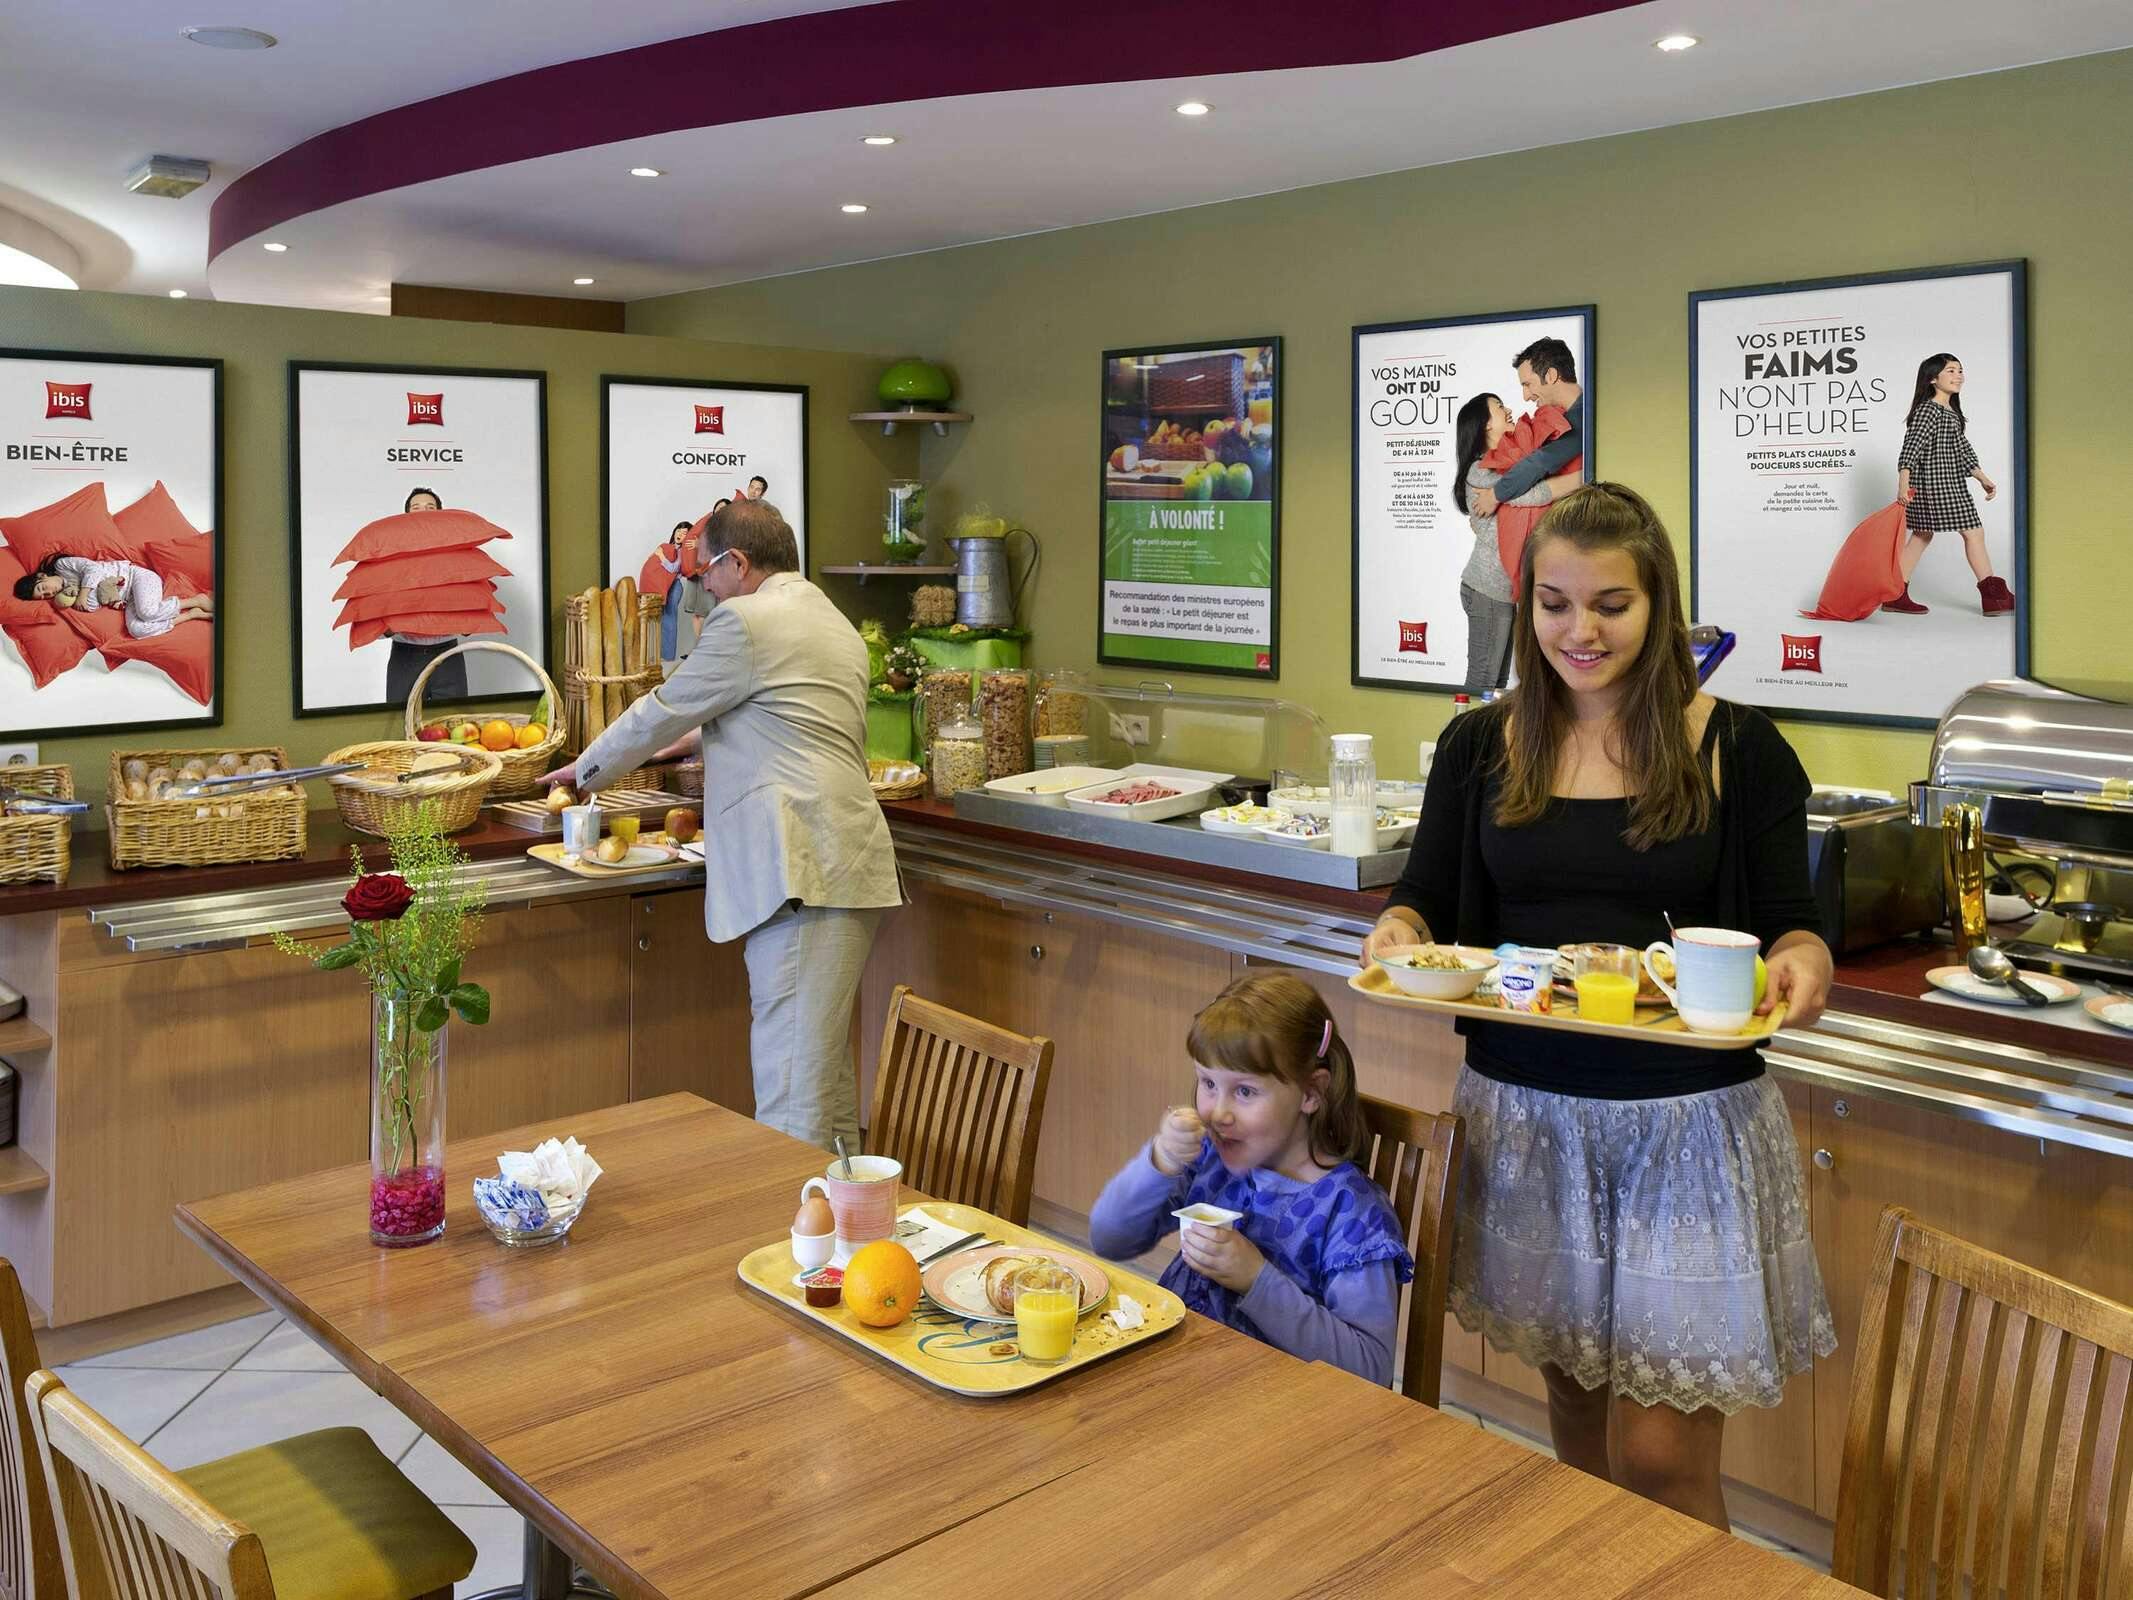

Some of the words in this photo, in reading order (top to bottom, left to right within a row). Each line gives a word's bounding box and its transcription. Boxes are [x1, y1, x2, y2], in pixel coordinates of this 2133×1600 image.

[1737, 333, 1777, 349] VOS
[1783, 326, 1866, 347] PETITES
[1744, 347, 1858, 380] FAIMS
[1371, 366, 1400, 381] VOS
[1404, 363, 1457, 379] MATINS
[1386, 382, 1416, 395] ONT
[1420, 380, 1440, 393] DU
[1719, 382, 1817, 410] N'ONT
[1828, 378, 1887, 405] PAS
[53, 392, 85, 407] ibis
[413, 402, 438, 415] ibis
[1370, 393, 1459, 426] GOÛT
[699, 413, 720, 425] ibis
[1735, 408, 1869, 437] D'HEURE
[1386, 438, 1440, 448] PETIT-DÉJEUNER
[7, 441, 128, 462] BIEN-ÊTRE
[387, 448, 464, 462] SERVICE
[672, 452, 747, 466] CONFORT
[1747, 452, 1777, 460] PETITS
[1778, 450, 1806, 459] PLATS
[1807, 449, 1847, 458] CHAUDS
[1849, 449, 1857, 457] &
[1750, 461, 1801, 470] DOUCEURS
[1802, 458, 1853, 469] SUCRÉES...
[1150, 505, 1159, 529] À
[1160, 505, 1216, 530] VOLONTÉ
[1219, 509, 1225, 530] !
[1109, 590, 1171, 602] Recommandation
[1172, 594, 1186, 603] des
[1187, 595, 1222, 605] ministres
[1223, 597, 1265, 608] européens
[1122, 604, 1132, 613] de
[1132, 605, 1140, 613] la
[1140, 605, 1161, 615] santé
[1172, 607, 1182, 617] Le
[1182, 608, 1200, 619] petit
[1201, 609, 1235, 621] déjeuner
[1236, 611, 1249, 620] est
[1113, 617, 1120, 625] le
[1120, 619, 1140, 628] repas
[1141, 618, 1148, 627] le
[1149, 620, 1165, 631] plus
[1166, 621, 1202, 633] important
[1203, 623, 1214, 632] de
[1215, 624, 1223, 633] la
[1224, 625, 1254, 636] journée
[1403, 629, 1423, 642] ibis
[1788, 644, 1816, 660] ibis
